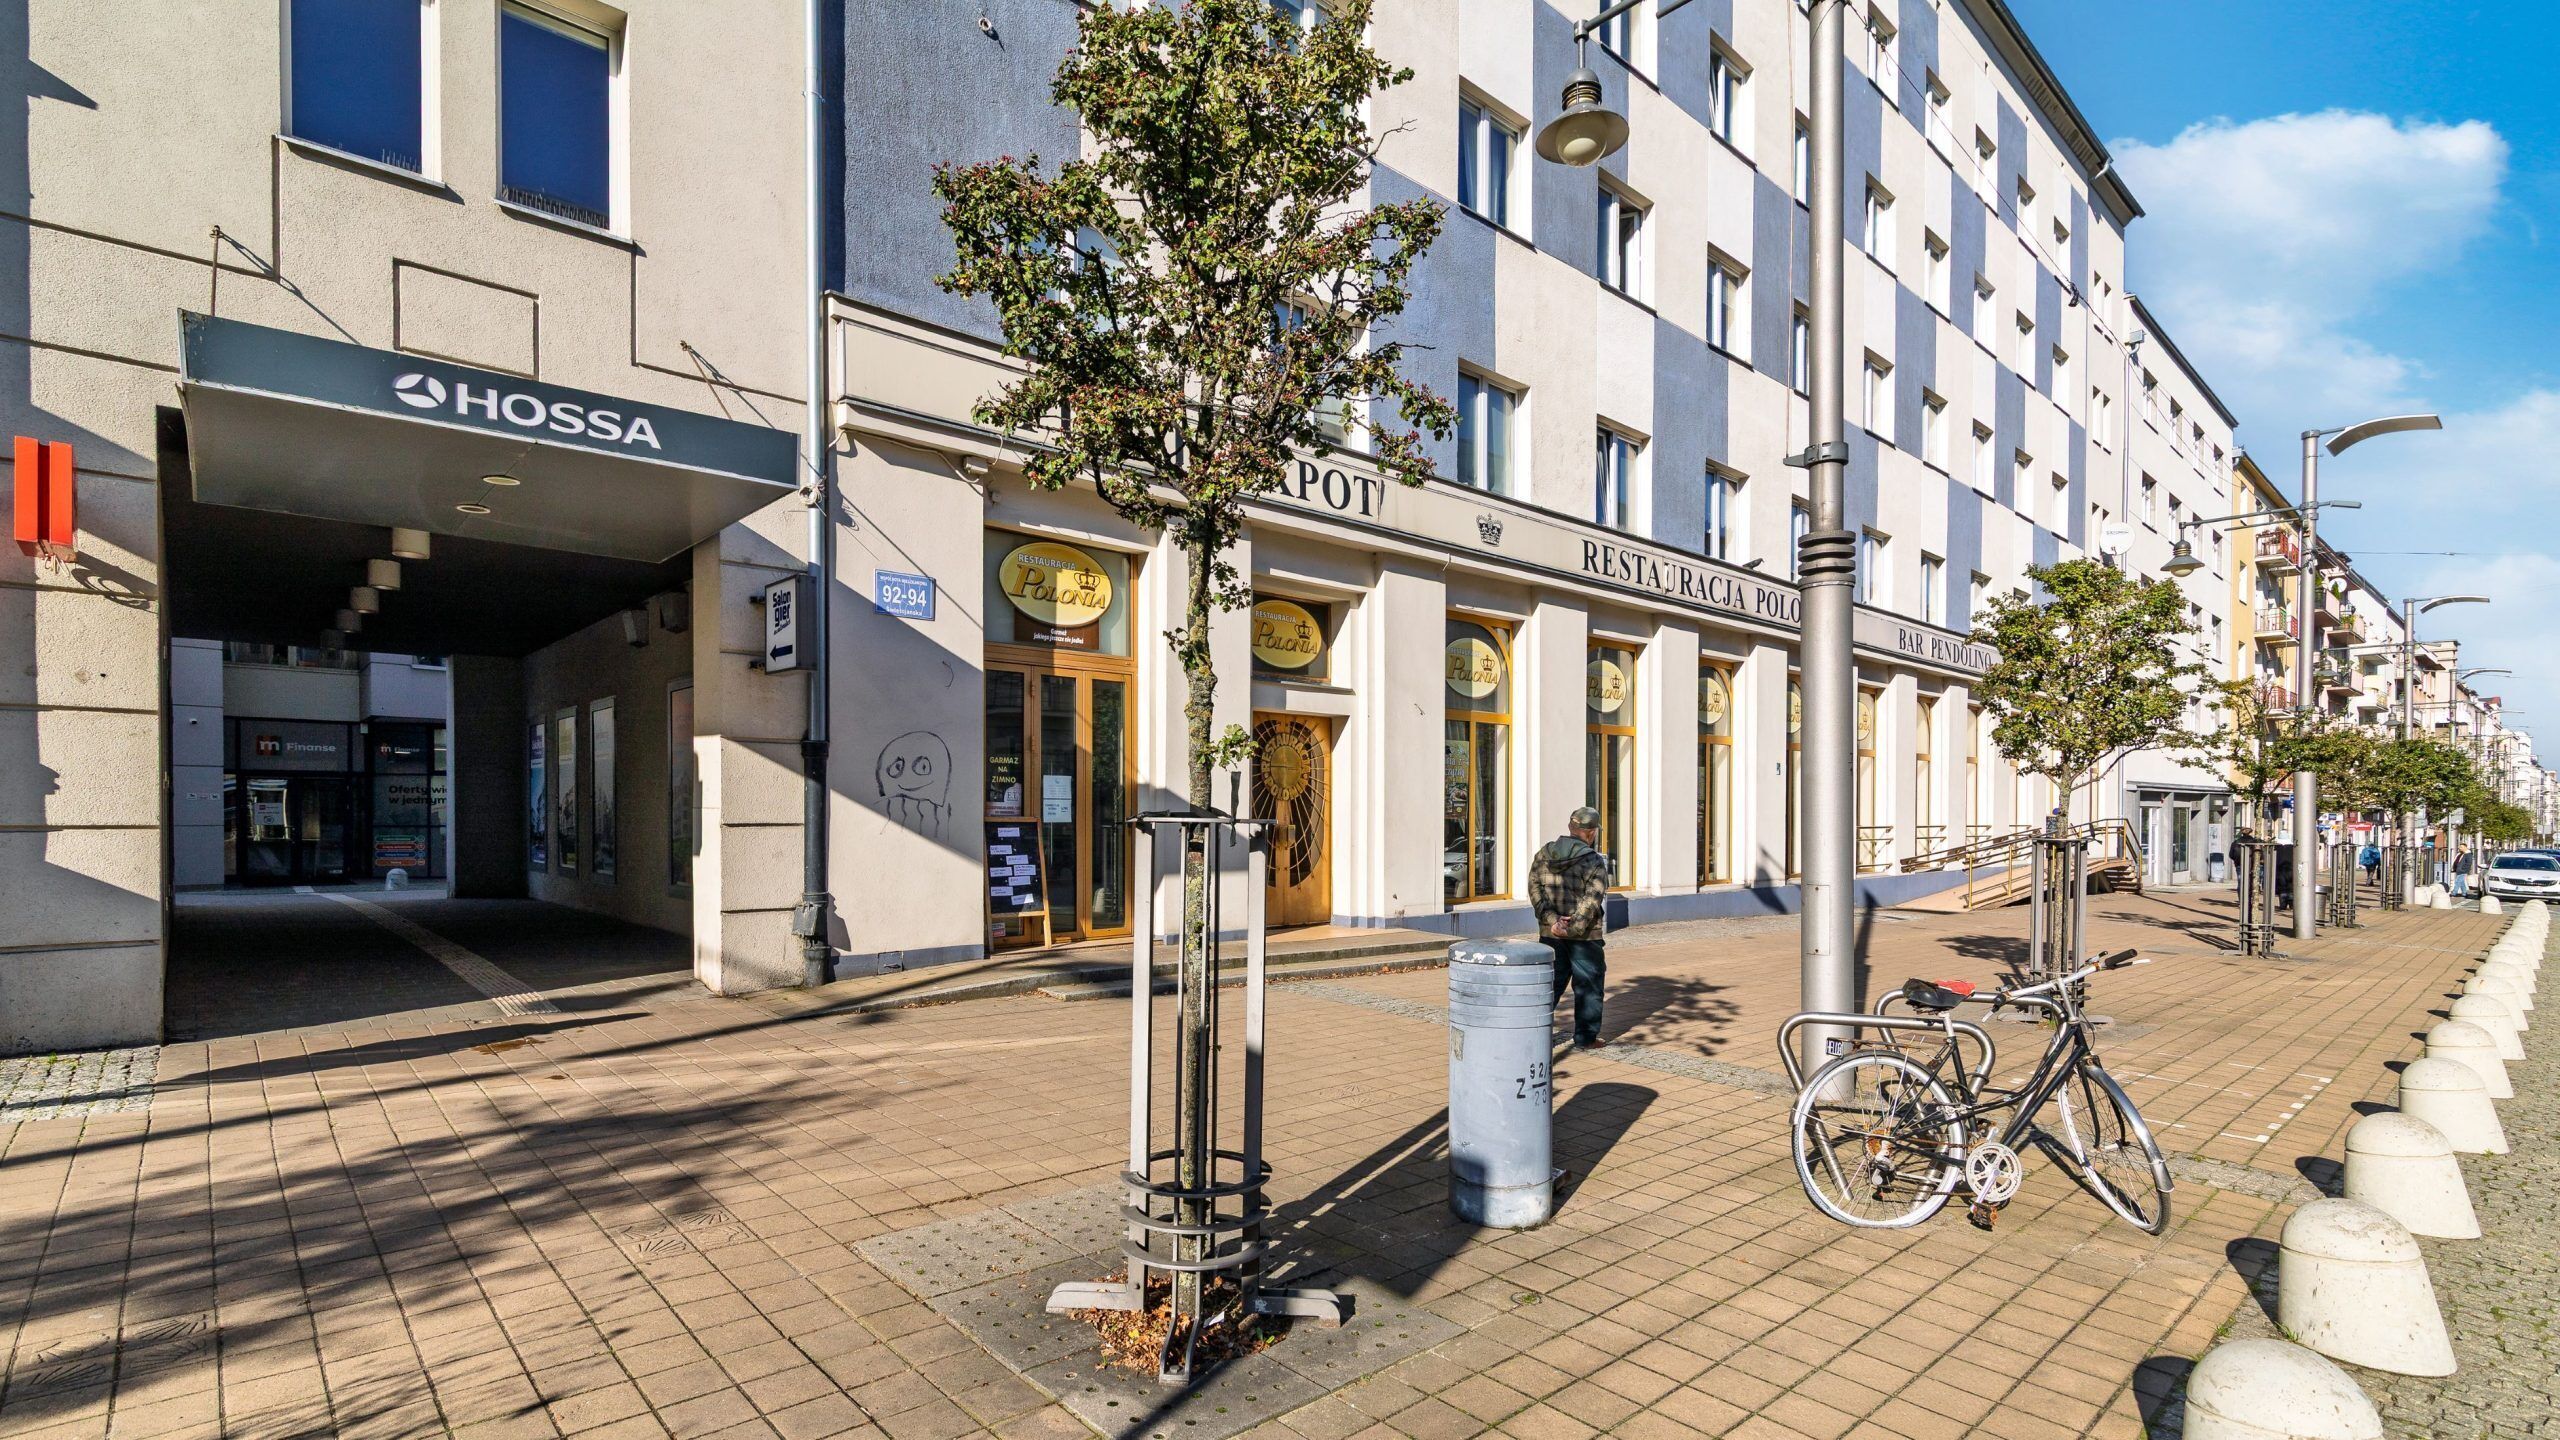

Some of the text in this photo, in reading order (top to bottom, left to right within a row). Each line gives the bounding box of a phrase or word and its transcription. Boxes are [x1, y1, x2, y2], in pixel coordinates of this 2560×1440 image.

[455, 382, 662, 450] HOSSA
[1279, 456, 1378, 518] POT
[1018, 553, 1077, 570] RESTAURACJA
[1007, 564, 1106, 610] POLONIA
[1581, 538, 1801, 624] RESTAURACJA POLO
[772, 589, 791, 608] Salon
[882, 585, 927, 607] 92-94
[774, 603, 791, 628] gier
[1255, 610, 1297, 623] RESTAURACJA
[1252, 618, 1318, 655] POLONIA
[1898, 627, 1992, 671] BAR PENDOLINO
[1446, 654, 1498, 685] POLONIA
[286, 742, 337, 752] Finanse
[388, 785, 428, 796] Oferty
[991, 775, 1017, 784] ZIMNO
[1516, 1077, 1526, 1099] Z
